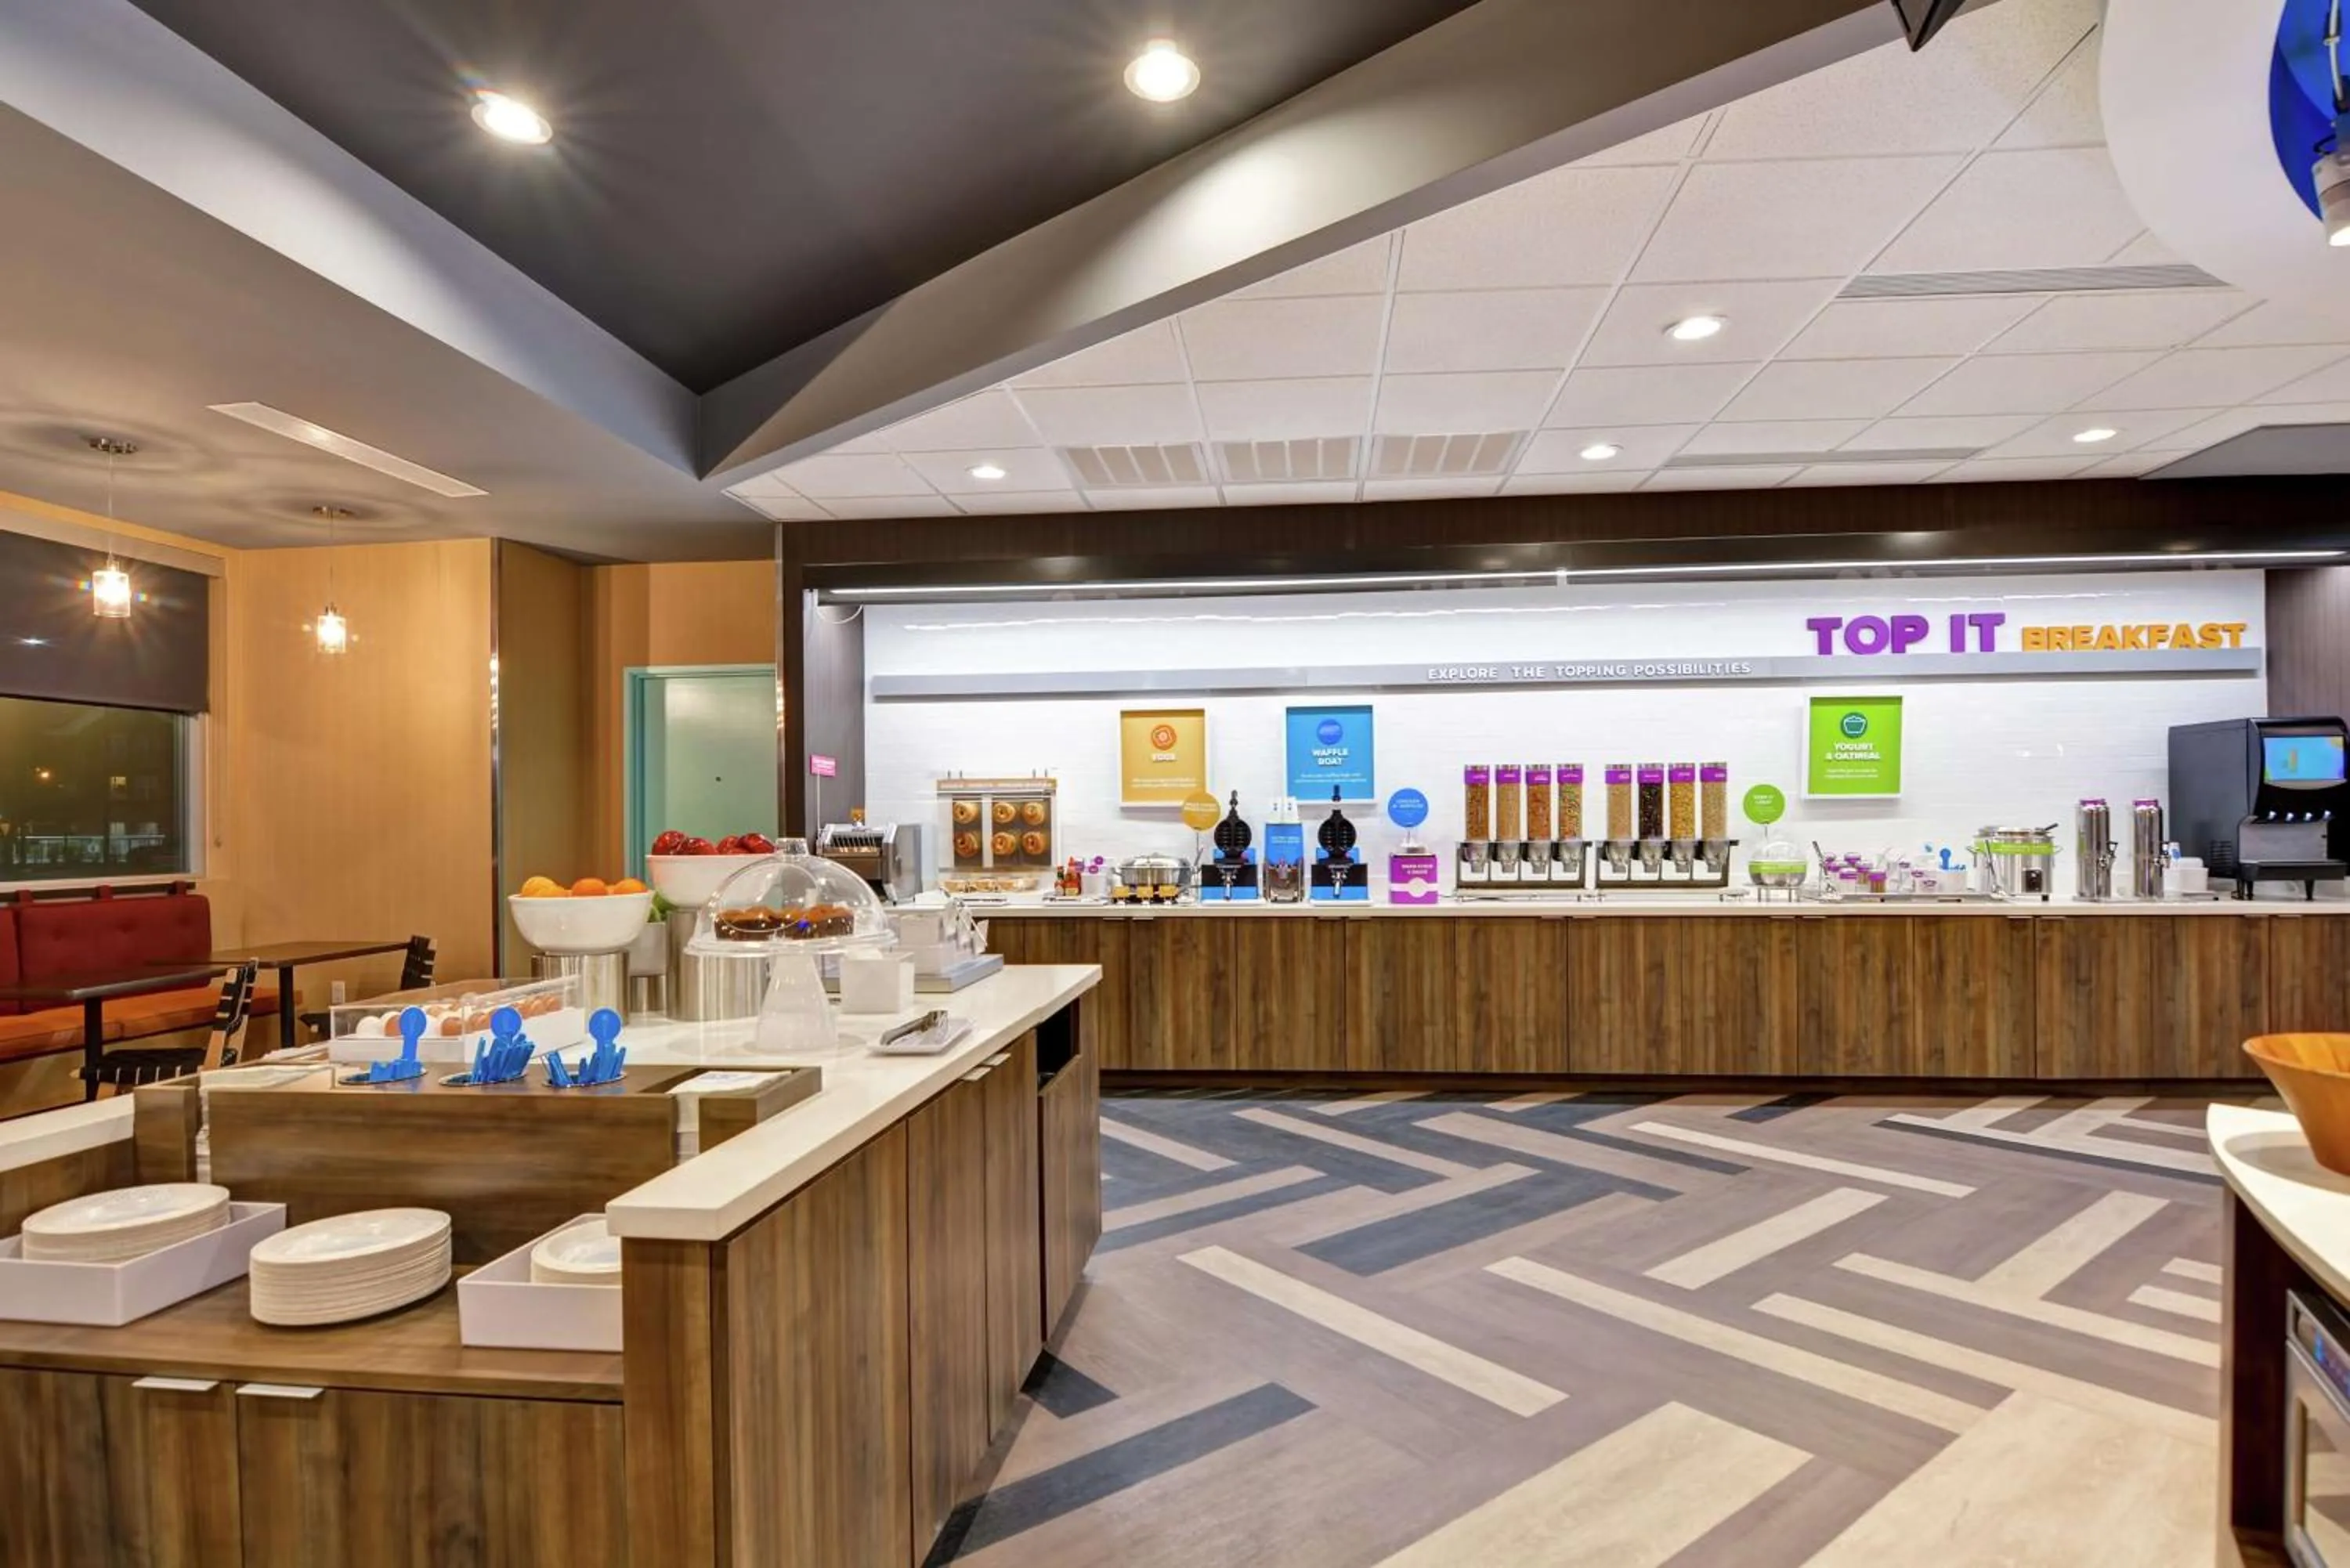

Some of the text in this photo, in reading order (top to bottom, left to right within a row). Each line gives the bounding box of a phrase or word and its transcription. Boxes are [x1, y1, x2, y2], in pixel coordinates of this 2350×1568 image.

[1807, 612, 2247, 656] TOP IT BREAKFAST
[1428, 662, 1752, 680] EXPLORE THE TOPPING POSSIBILITIES
[1311, 748, 1348, 757] WAFFLE
[1834, 742, 1873, 751] YOGURT
